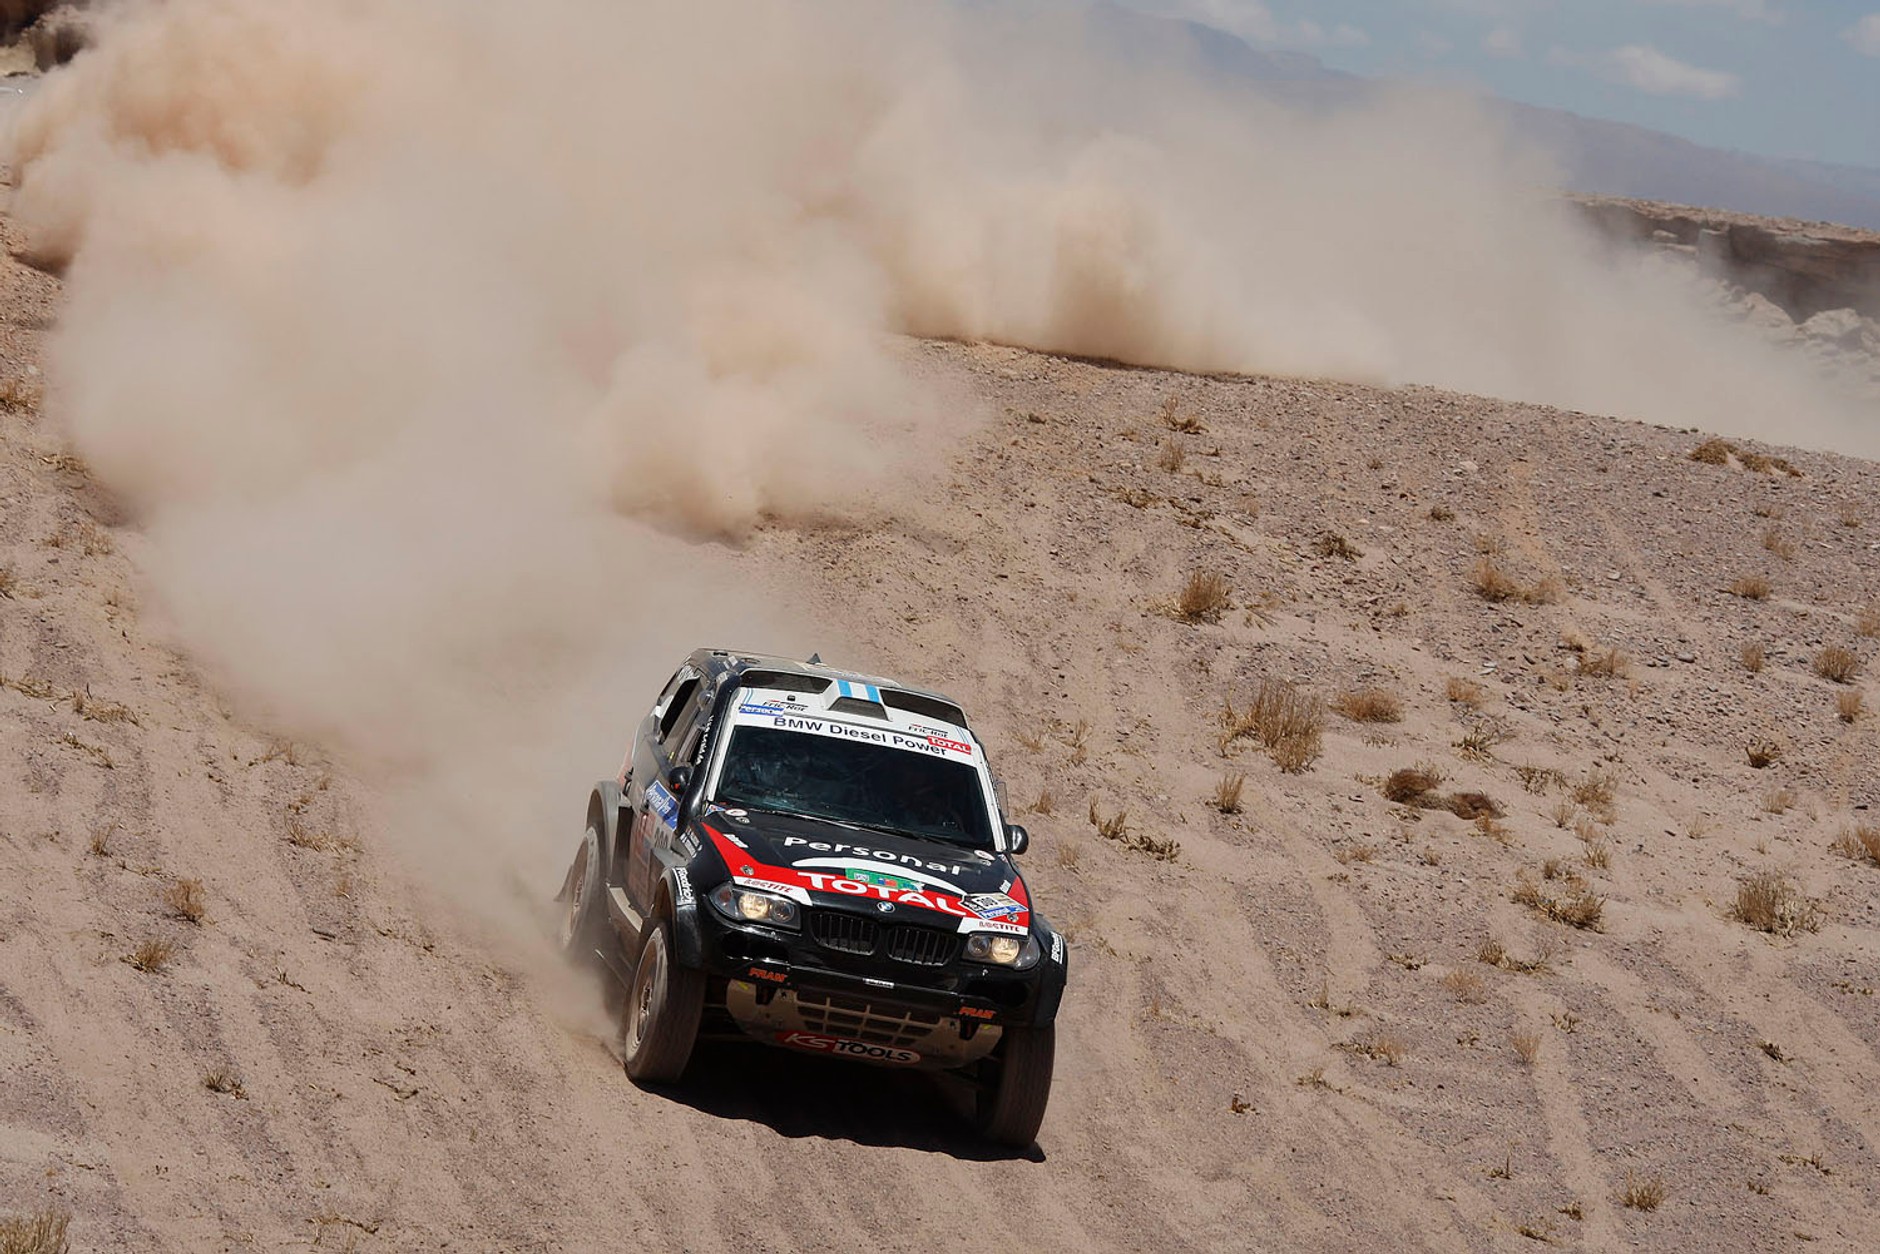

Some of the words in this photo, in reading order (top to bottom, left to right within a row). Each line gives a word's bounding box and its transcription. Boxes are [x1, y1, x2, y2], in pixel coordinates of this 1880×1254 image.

[773, 717, 824, 732] BMW
[829, 724, 887, 743] Diesel
[893, 735, 948, 755] Power
[929, 737, 969, 753] TOTAL
[784, 836, 961, 876] Personal
[743, 878, 794, 894] LOCTITE
[798, 871, 967, 916] TOTAL
[978, 921, 1020, 933] LOCTITE
[748, 967, 788, 983] FRAM
[958, 1006, 997, 1020] FRAM
[783, 1033, 834, 1050] KS
[833, 1040, 913, 1063] TOOLS
